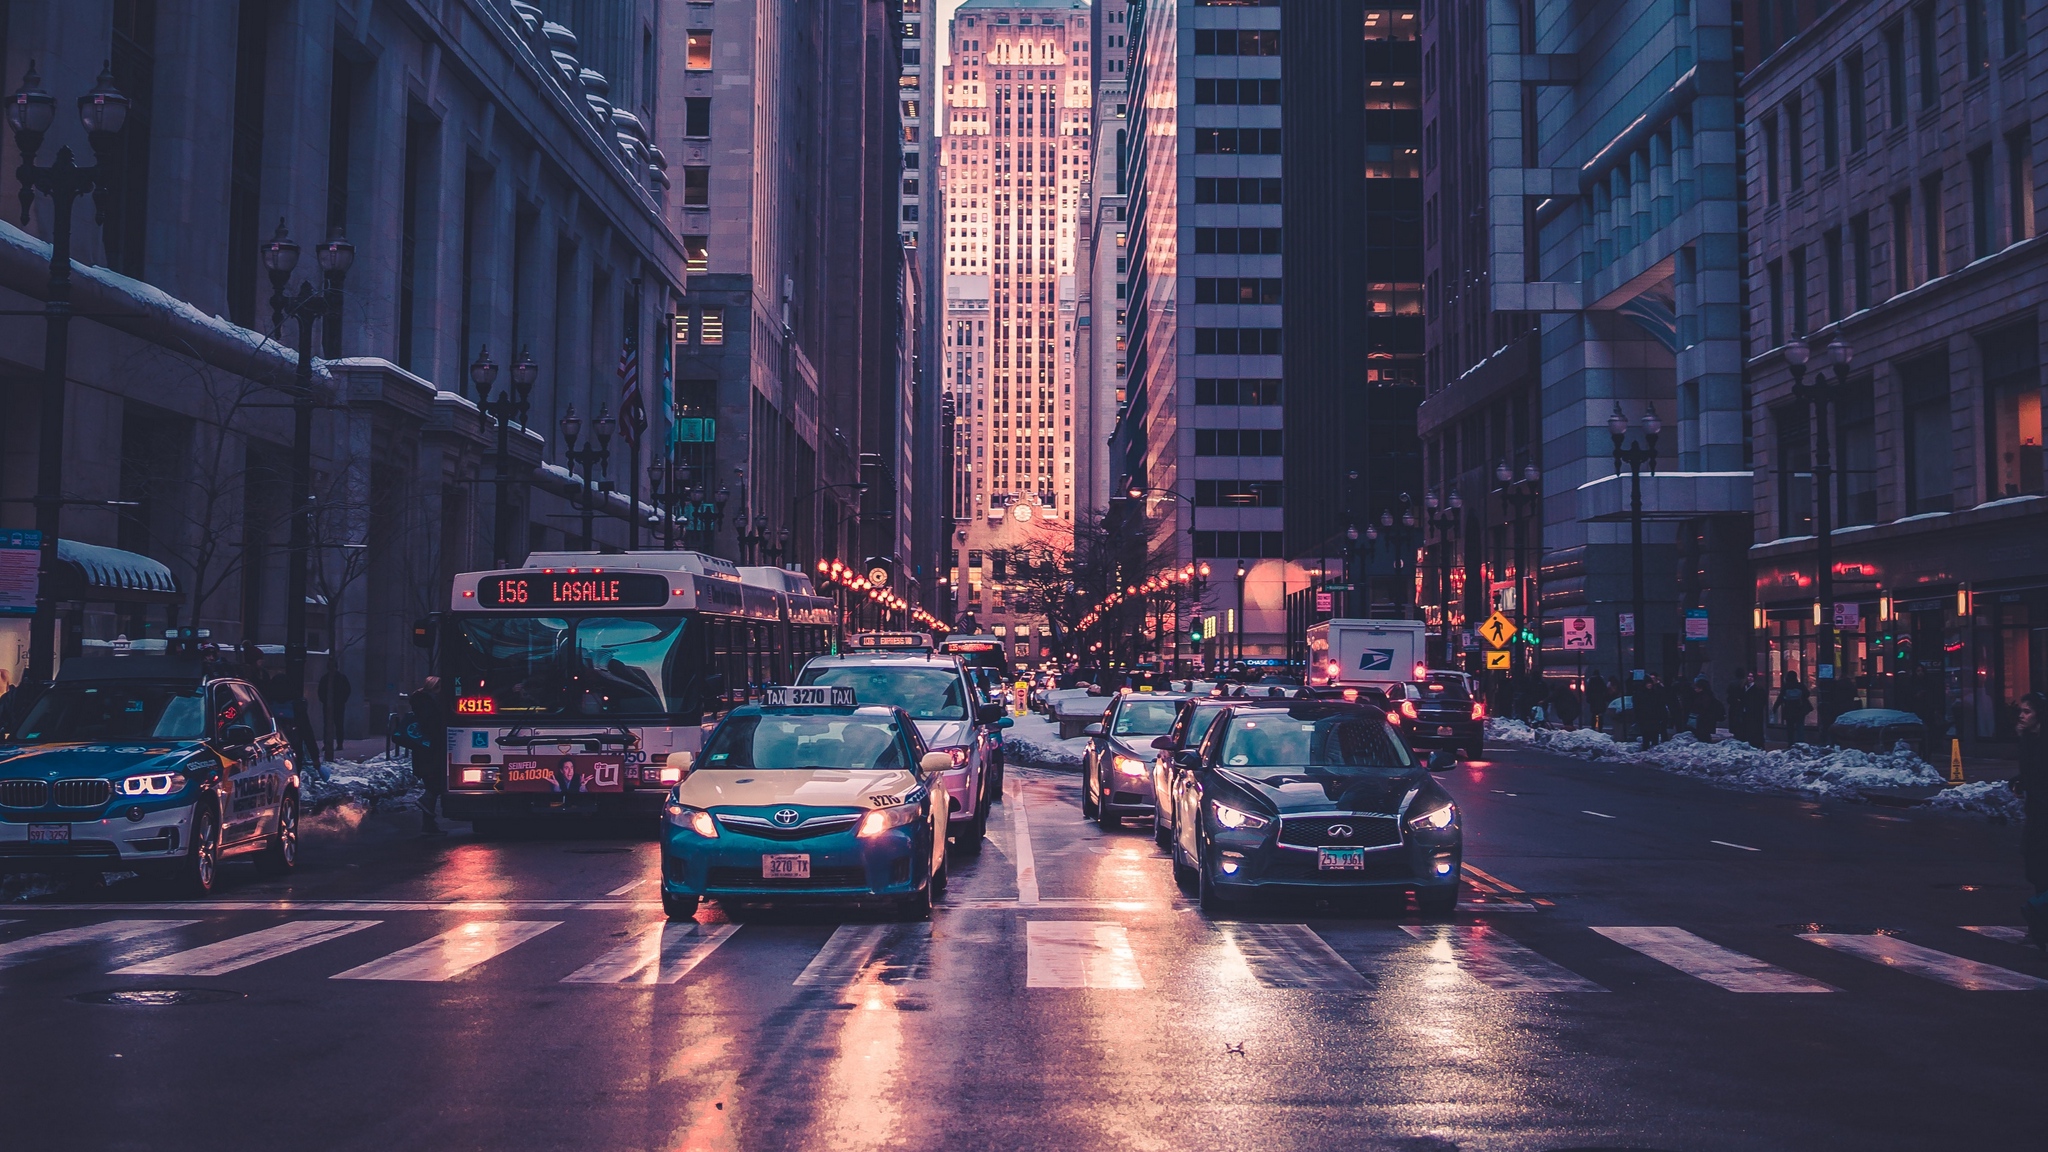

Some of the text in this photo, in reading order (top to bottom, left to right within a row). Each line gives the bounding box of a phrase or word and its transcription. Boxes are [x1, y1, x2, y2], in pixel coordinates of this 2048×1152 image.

[498, 580, 619, 603] 156 LASALLE
[766, 688, 853, 705] TAXI 3270 TAXI
[458, 699, 493, 712] K915
[508, 761, 537, 771] SEINFELD
[868, 794, 901, 807] 3270
[770, 860, 808, 872] 3270 TX
[1321, 854, 1362, 865] 253 9361
